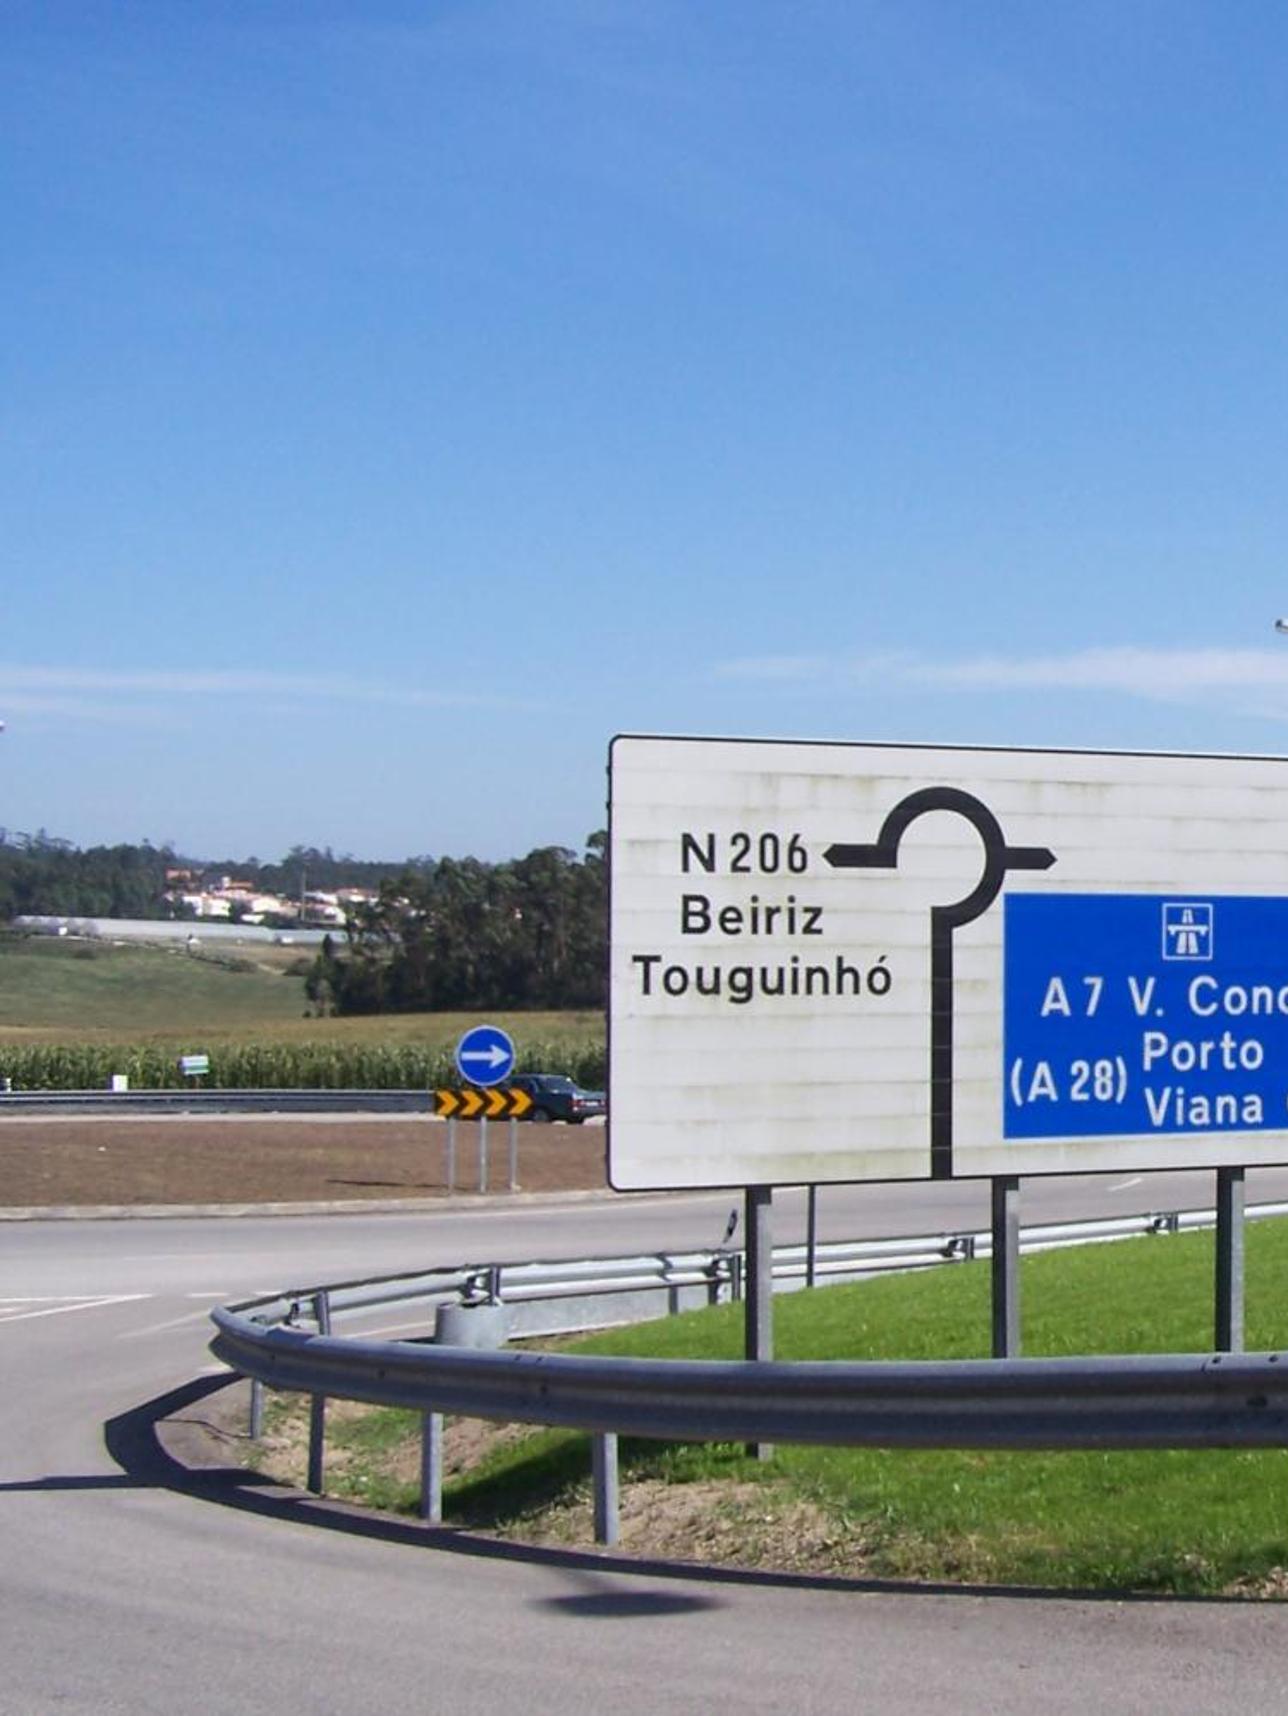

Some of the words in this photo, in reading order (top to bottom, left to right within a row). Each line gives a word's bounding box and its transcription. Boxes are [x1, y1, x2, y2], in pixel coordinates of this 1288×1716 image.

[681, 832, 716, 873] N
[730, 832, 808, 874] 206
[681, 894, 823, 936] Beiriz
[631, 954, 892, 1005] Touguinhó
[1040, 976, 1071, 1016] A
[1084, 977, 1103, 1016] 7
[1128, 977, 1164, 1016] V.
[1143, 1031, 1264, 1072] Porto
[1010, 1057, 1058, 1106] (A
[1070, 1056, 1128, 1104] 28)
[1144, 1086, 1264, 1127] Viana
